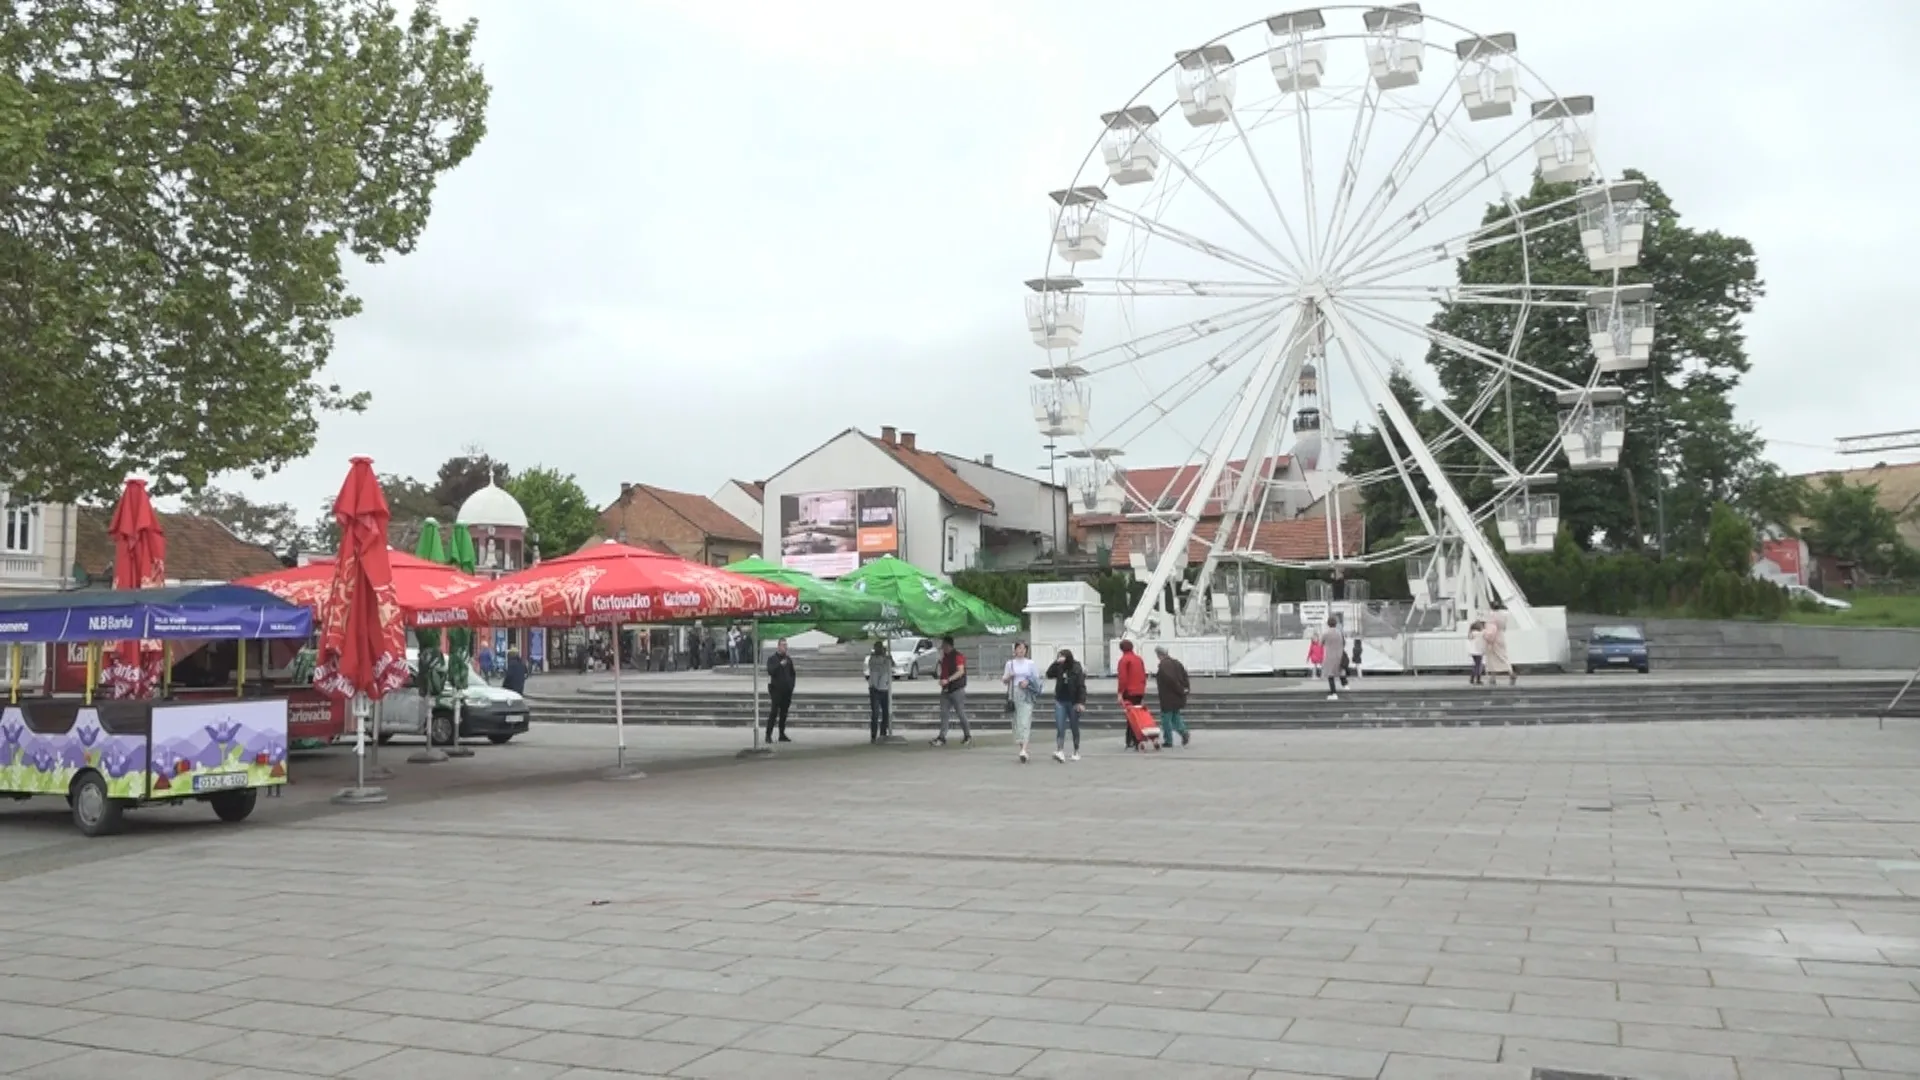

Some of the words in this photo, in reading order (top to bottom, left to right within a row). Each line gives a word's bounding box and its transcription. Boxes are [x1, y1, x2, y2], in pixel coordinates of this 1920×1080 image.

[592, 593, 651, 610] Karlovačko
[88, 616, 107, 630] NLB
[108, 614, 133, 629] Banka
[416, 607, 468, 624] Karlovačko
